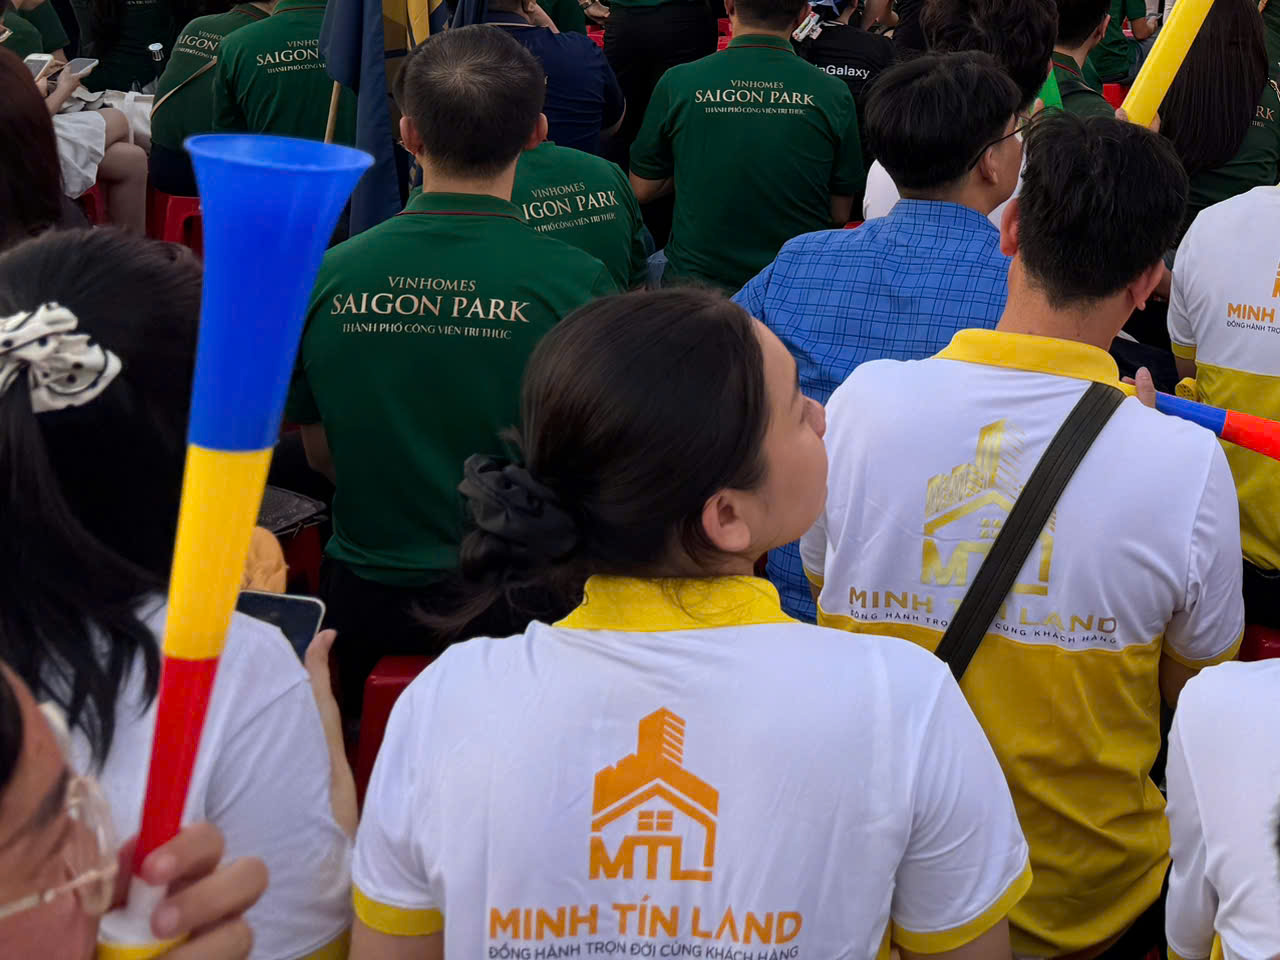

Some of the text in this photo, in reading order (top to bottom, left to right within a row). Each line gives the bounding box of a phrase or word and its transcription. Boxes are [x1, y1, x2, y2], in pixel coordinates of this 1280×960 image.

[287, 39, 319, 48] VINHO
[256, 48, 318, 66] SAIGON
[731, 79, 784, 89] VINHOMES
[695, 89, 815, 106] SAIGON PARK
[1256, 105, 1275, 121] RK
[531, 181, 585, 198] VINHOMES
[522, 190, 619, 221] IGON PARK
[388, 276, 476, 292] VINHOMES
[330, 292, 530, 323] SAIGON PARK
[1227, 303, 1276, 324] MINH
[342, 322, 377, 334] THÀNH
[379, 321, 403, 333] PHỐ
[404, 322, 437, 336] CÔNG
[438, 324, 462, 336] VIÊN
[463, 326, 479, 337] TRI
[849, 586, 933, 614] MINH
[1020, 607, 1117, 635] LAND
[885, 611, 919, 622] HÀNH
[1035, 629, 1076, 644] KHÁCH
[589, 835, 713, 882] MTL
[489, 894, 803, 944] MINH TÍN LAND
[489, 942, 531, 960] ĐỒNG
[535, 942, 581, 959] HÀNH
[586, 940, 627, 956] TRỌN
[630, 941, 657, 958] ĐỜI
[660, 940, 702, 958] CÙNG
[758, 944, 801, 960] HÀNG
